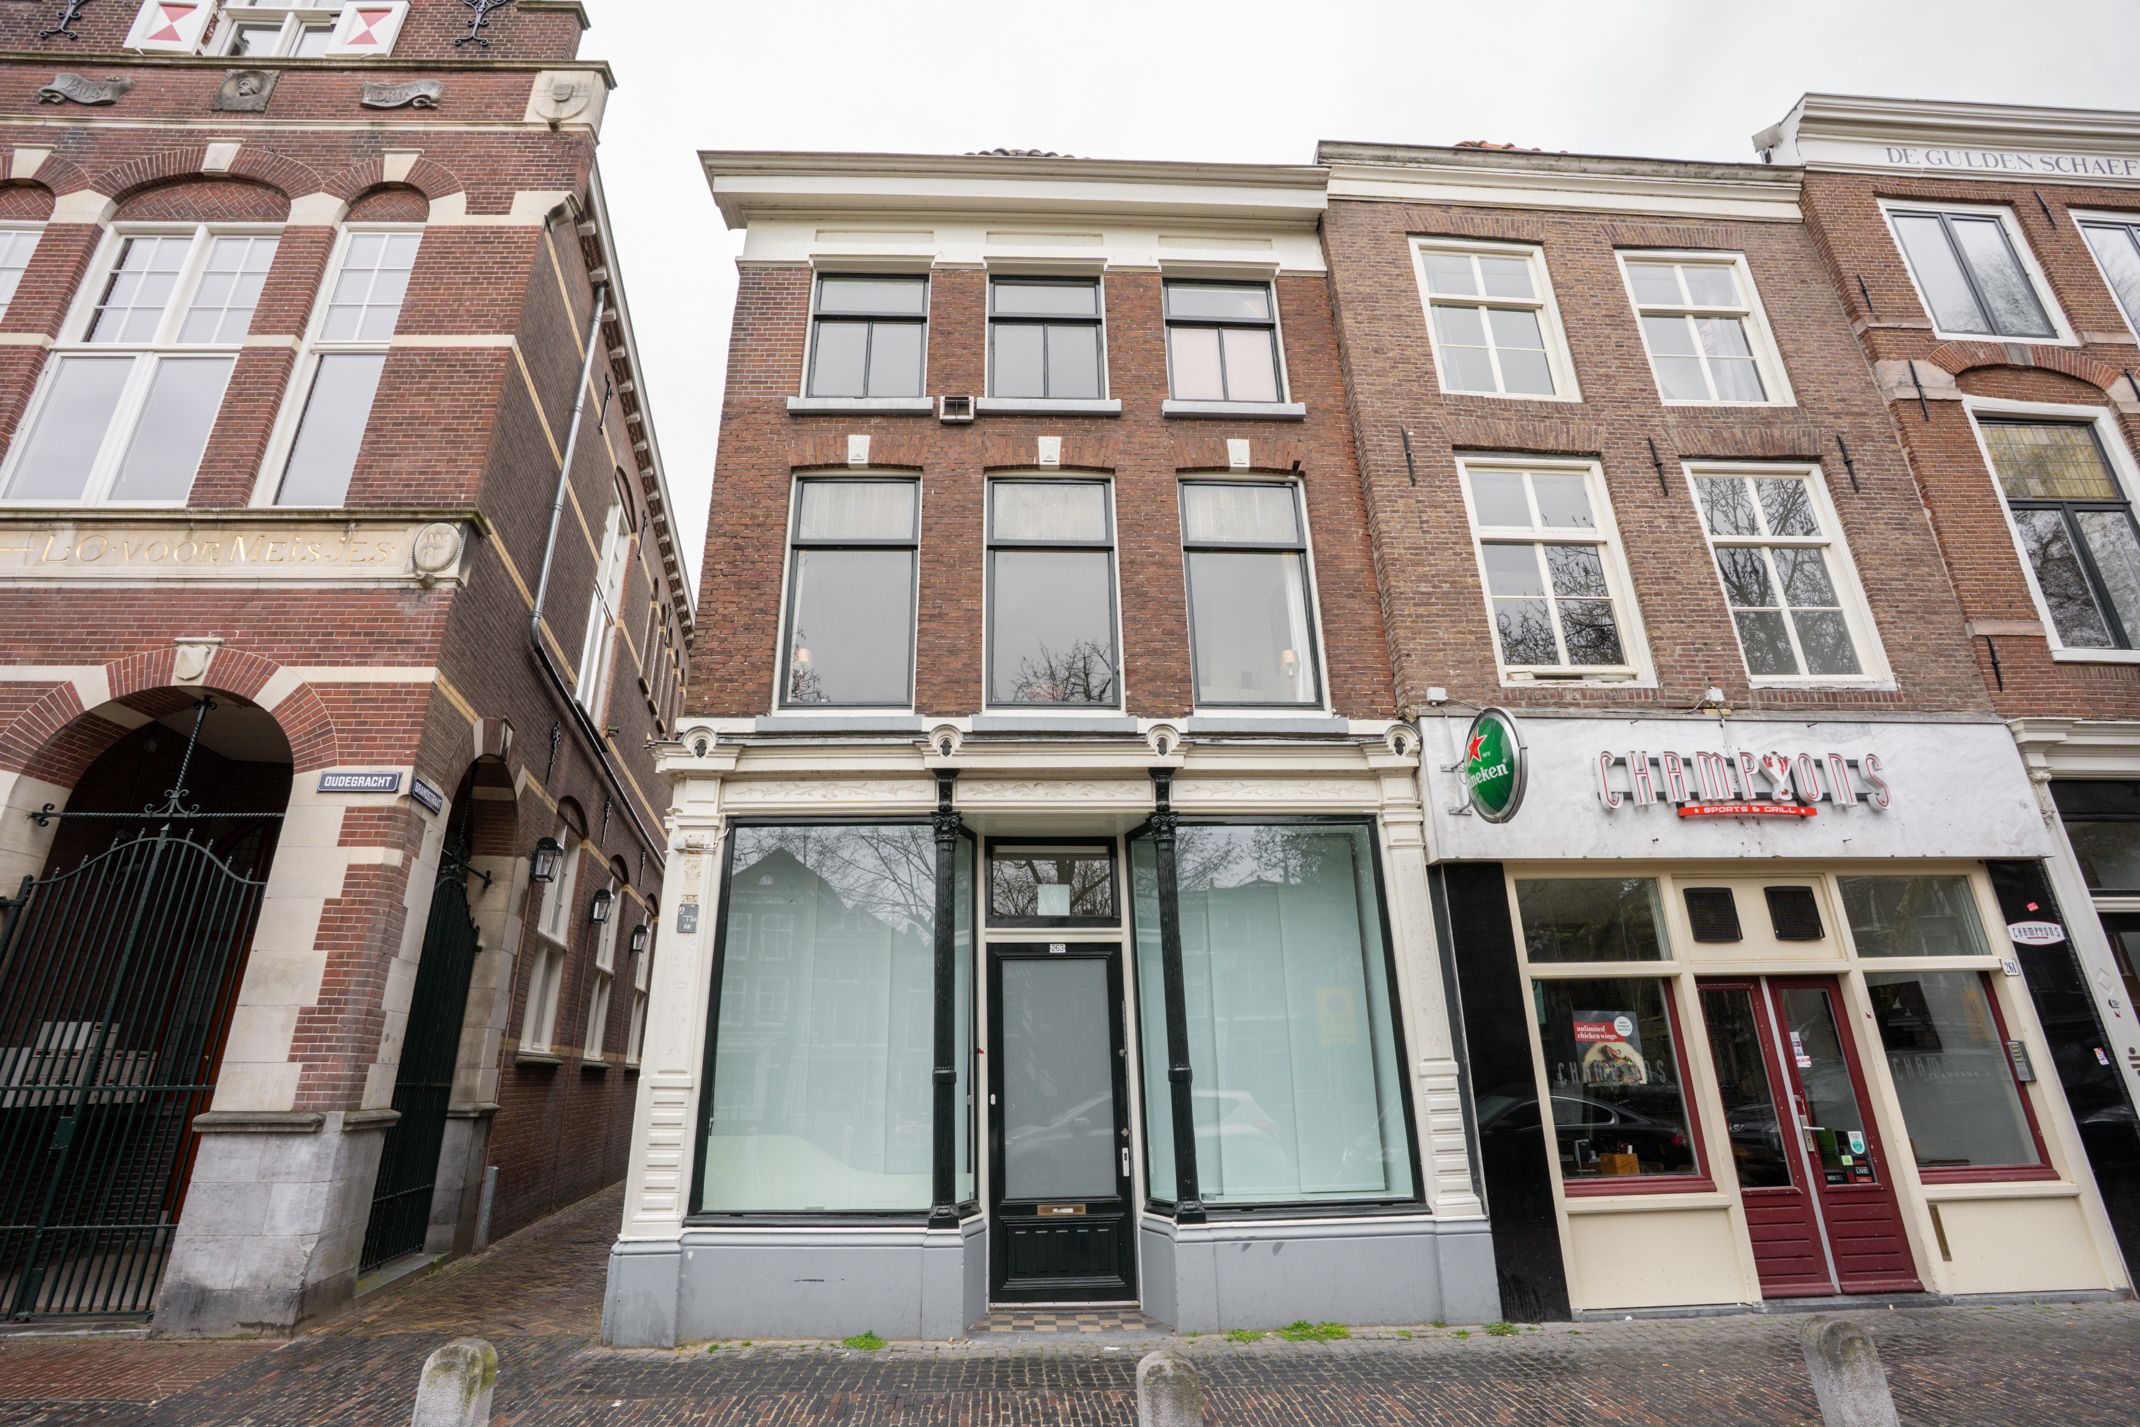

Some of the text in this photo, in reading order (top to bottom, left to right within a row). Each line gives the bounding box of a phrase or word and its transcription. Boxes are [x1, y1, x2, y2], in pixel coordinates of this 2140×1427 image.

[1886, 147, 2138, 176] DE GULDEN SCHAEF
[324, 776, 393, 787] OUDEGRACHT
[1050, 944, 1065, 952] 263
